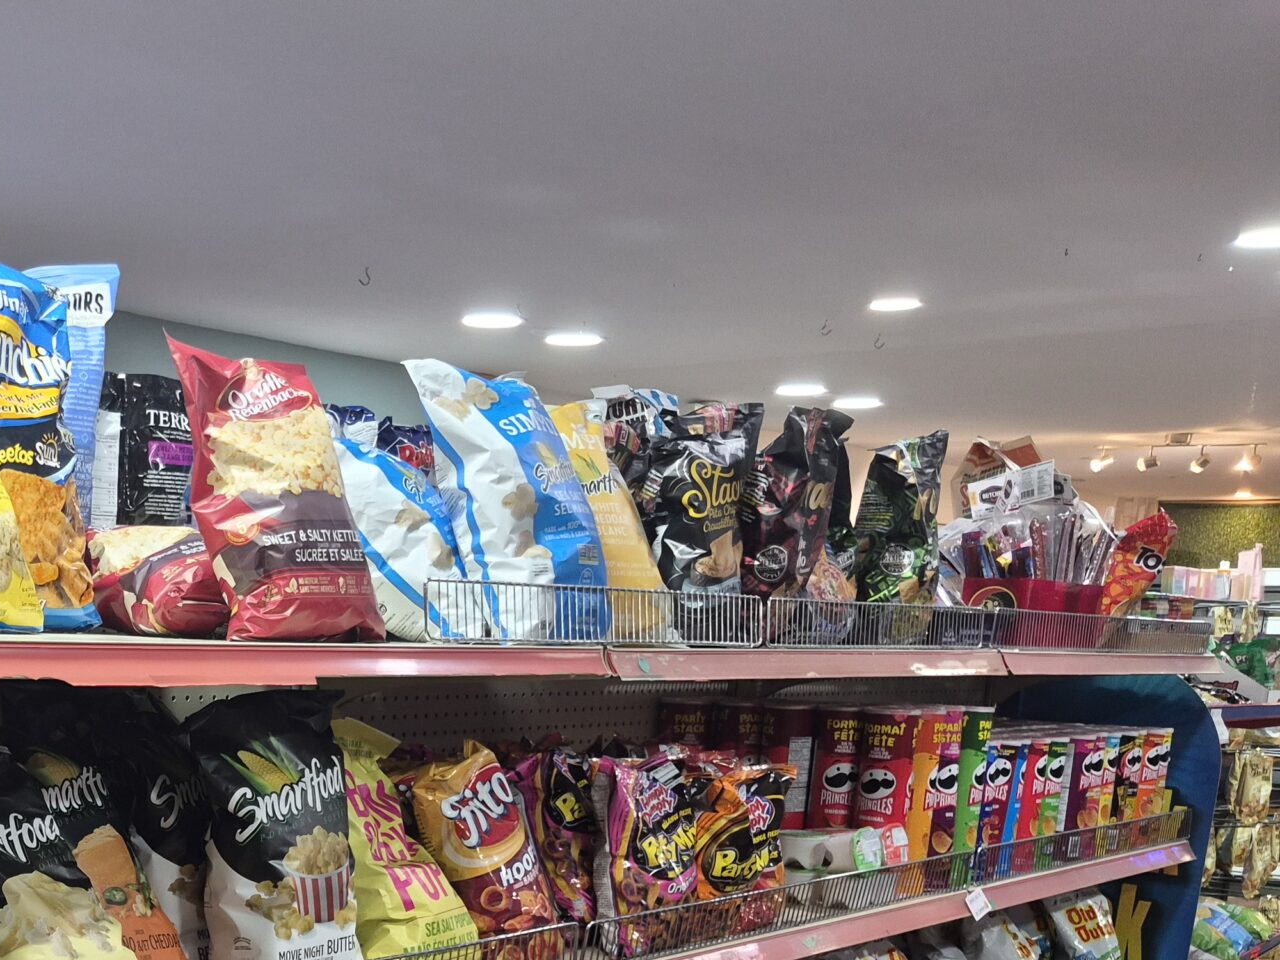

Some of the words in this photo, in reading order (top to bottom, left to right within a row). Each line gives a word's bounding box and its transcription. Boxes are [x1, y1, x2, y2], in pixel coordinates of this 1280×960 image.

[145, 408, 192, 432] TERR
[263, 530, 297, 547] SWEET
[299, 530, 307, 541] &
[308, 530, 331, 544] SALTY
[329, 549, 339, 562] ET
[228, 756, 346, 845] Smartfood
[385, 860, 449, 913] POP
[425, 921, 441, 938] SEA
[304, 944, 326, 960] NIGHT
[327, 934, 356, 956] BUTTER
